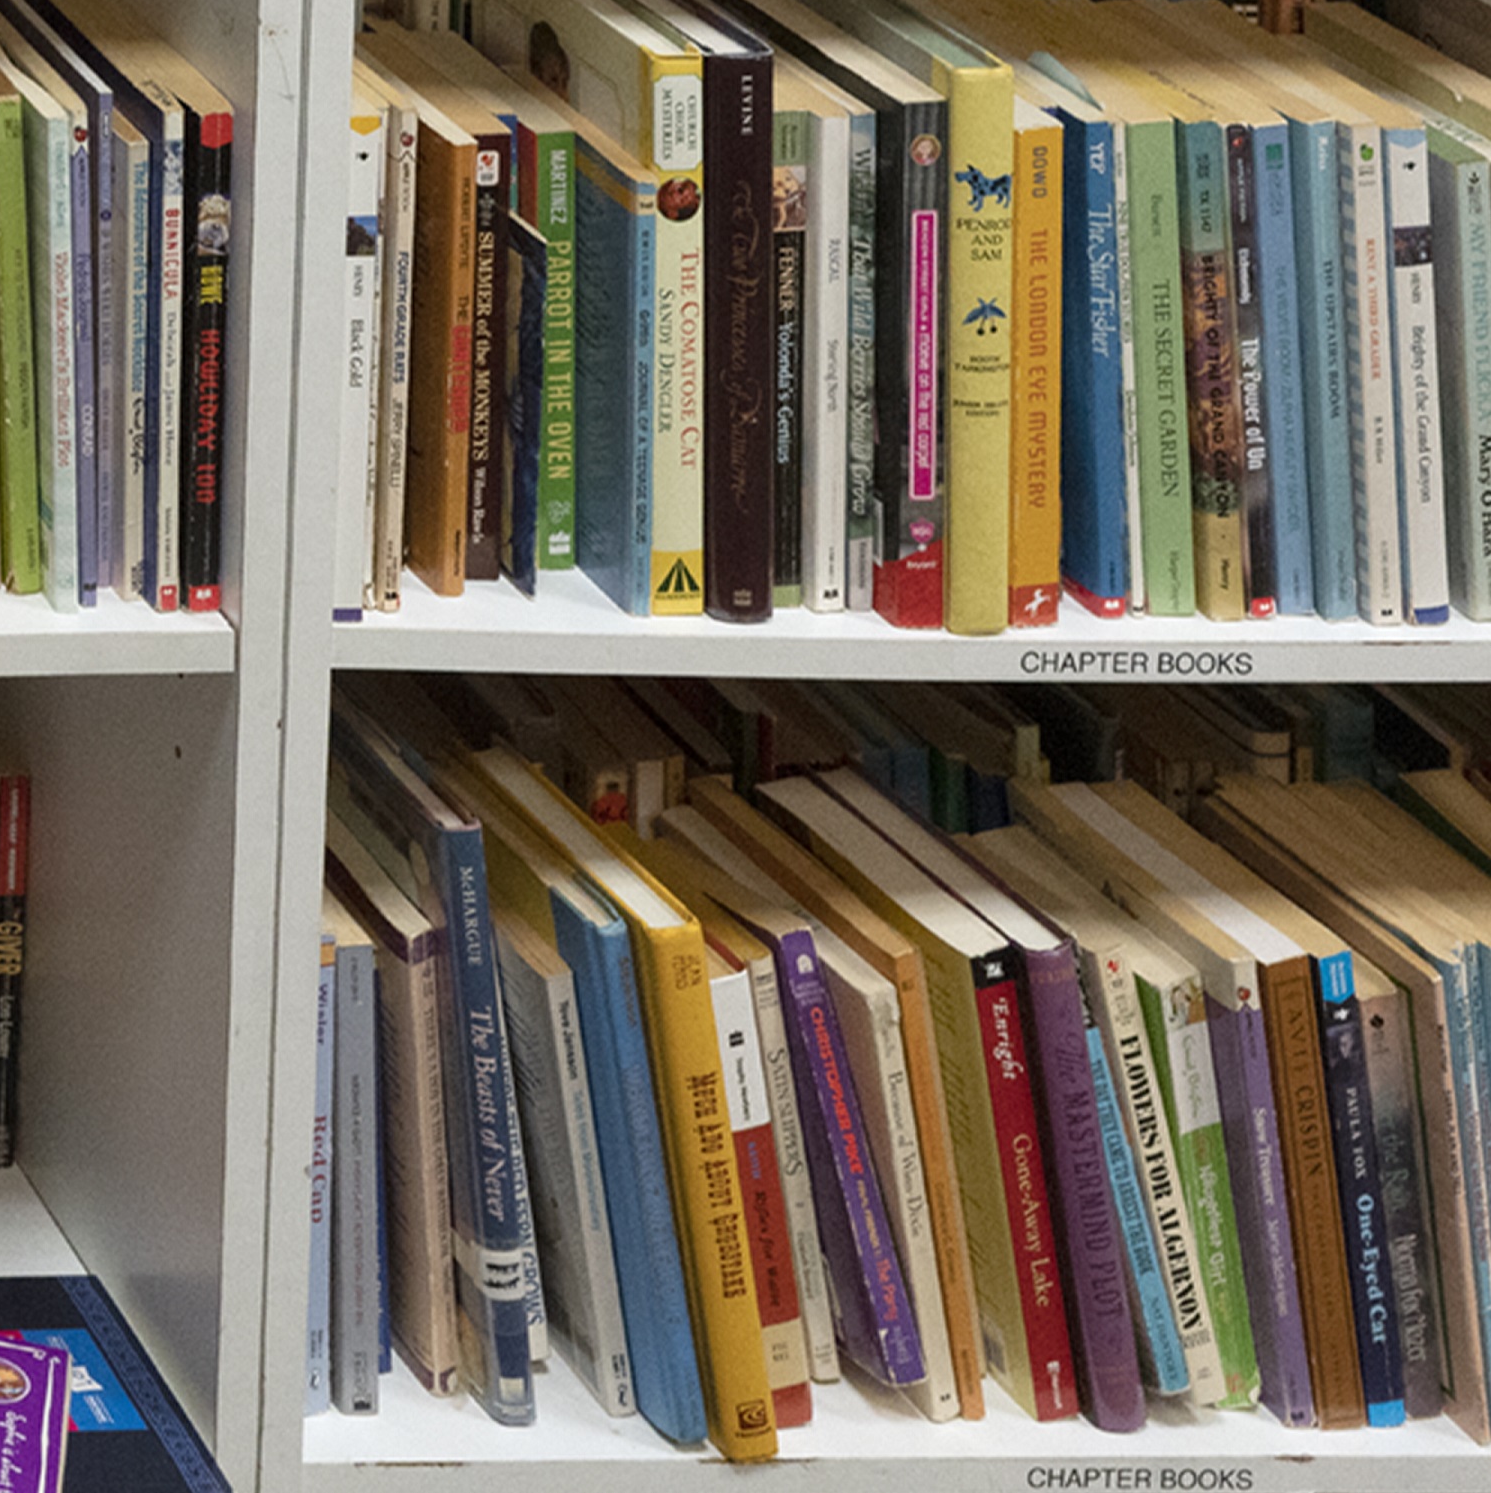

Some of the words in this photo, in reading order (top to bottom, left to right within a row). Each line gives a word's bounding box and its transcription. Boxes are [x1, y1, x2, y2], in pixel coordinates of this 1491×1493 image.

[550, 149, 568, 224] MARTINEZ
[547, 241, 570, 330] PARROT
[778, 247, 794, 312] FENNER
[1151, 280, 1173, 326] THE
[547, 340, 570, 364] IN
[1153, 329, 1176, 403] SECRET
[547, 373, 570, 411] THE
[547, 420, 570, 479] OVEN
[1157, 411, 1179, 497] GARDEN
[1020, 650, 1149, 674] CHAPTER
[1157, 651, 1253, 676] BOOKS
[1120, 1035, 1156, 1148] FLOWERS
[1011, 1135, 1047, 1251] Gone-Away
[1145, 1152, 1173, 1199] FOR
[1157, 1205, 1201, 1333] ALGERNON
[1358, 1195, 1383, 1298] One-Eyed
[1027, 1259, 1054, 1307] Lake
[1365, 1303, 1387, 1343] Cat
[1027, 1466, 1152, 1490] CHAPTER
[1160, 1468, 1253, 1491] BOOKS
